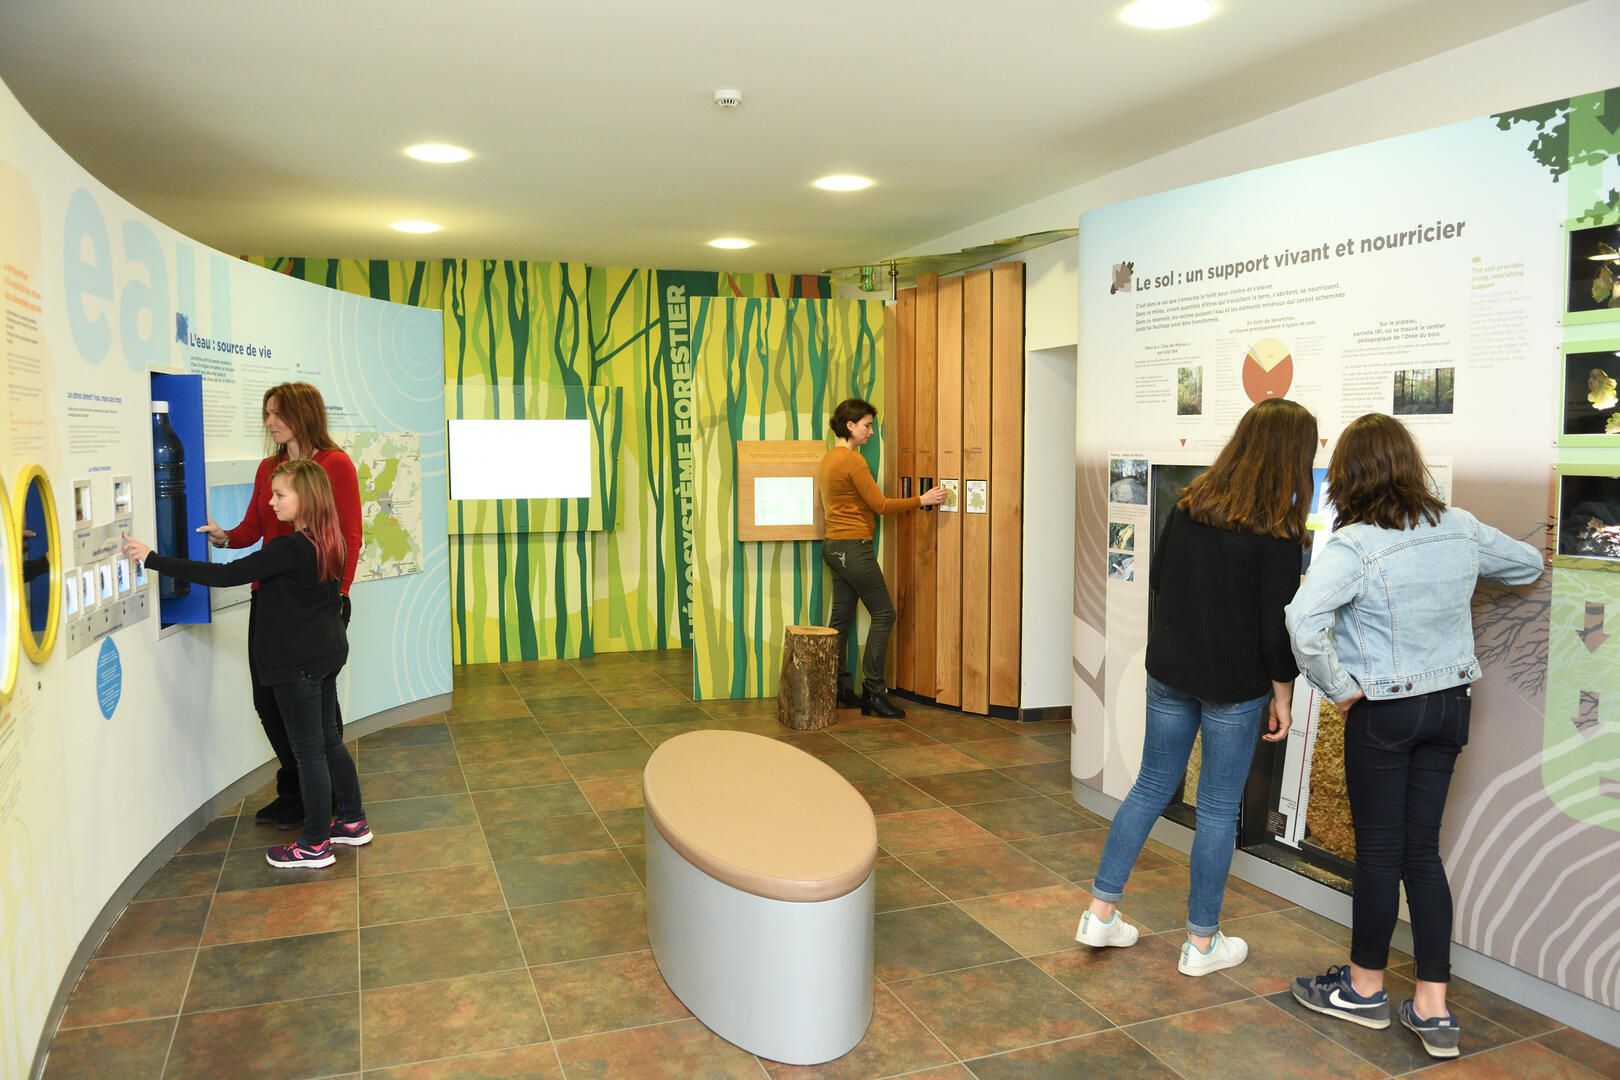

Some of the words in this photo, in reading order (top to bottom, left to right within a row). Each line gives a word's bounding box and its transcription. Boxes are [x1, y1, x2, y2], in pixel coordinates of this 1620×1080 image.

[63, 187, 233, 386] eau
[1136, 276, 1150, 292] Le
[1154, 270, 1174, 289] sol
[1178, 272, 1181, 284] :
[1186, 268, 1204, 284] un
[1207, 256, 1269, 280] support
[1274, 243, 1330, 268] vivant
[1335, 238, 1354, 257] et
[1360, 220, 1466, 253] nourricier
[1227, 295, 1250, 303] travaillent
[190, 333, 210, 349] L'eau
[217, 341, 244, 354] source
[246, 344, 256, 356] de
[259, 346, 271, 358] vie
[666, 285, 692, 436] FORESTIER
